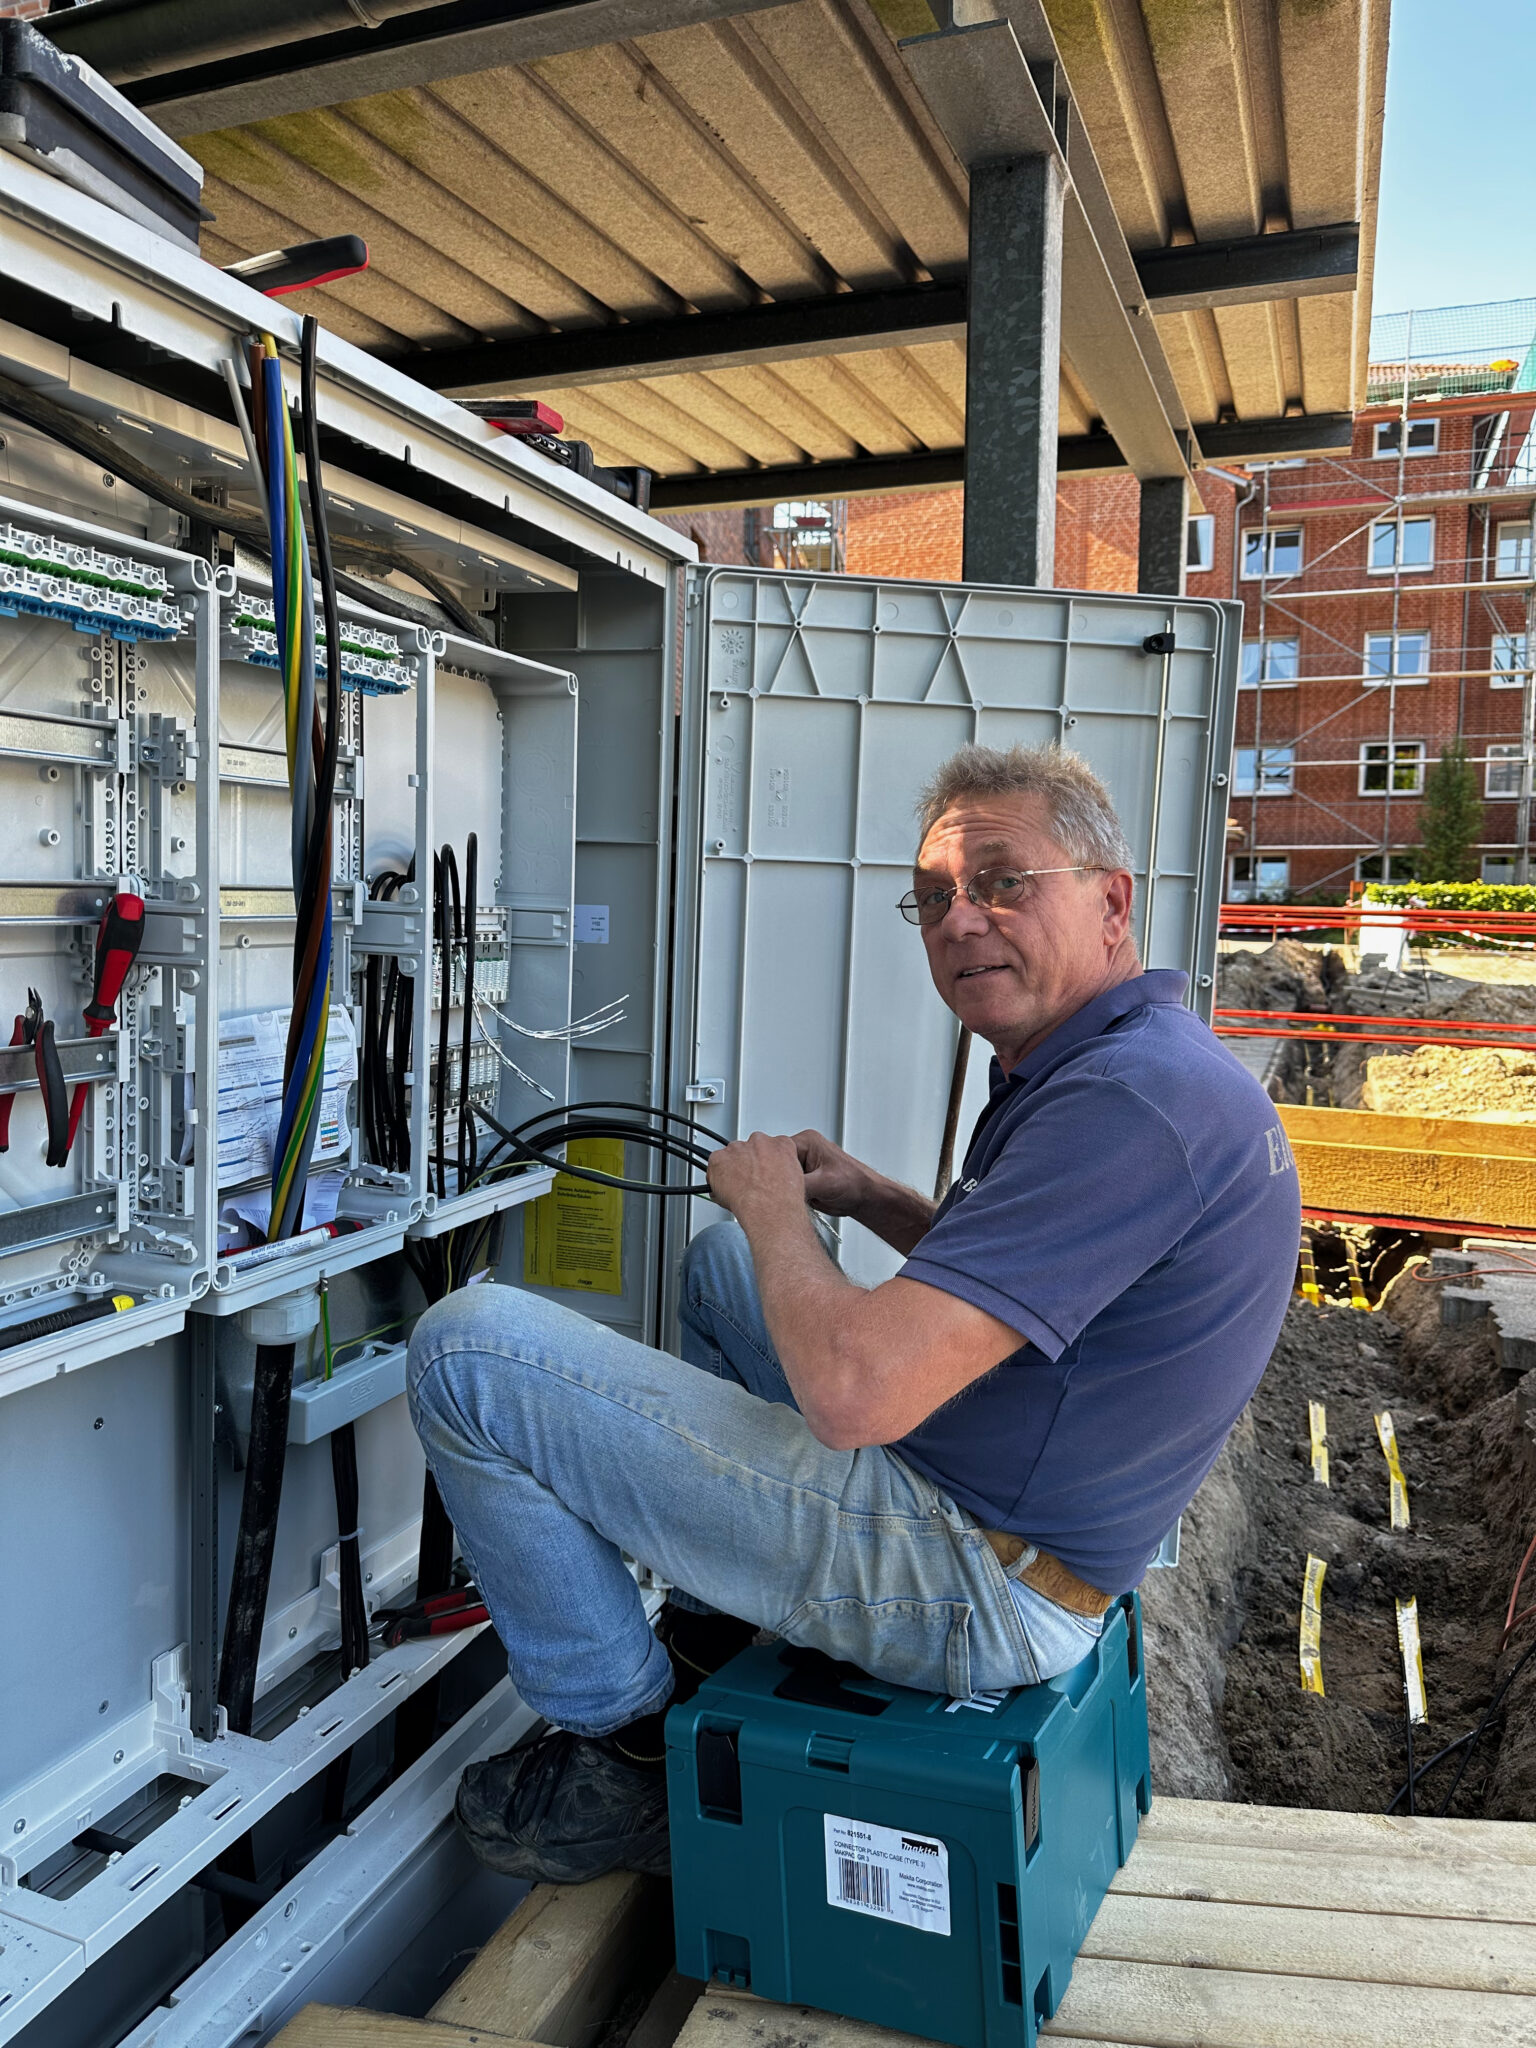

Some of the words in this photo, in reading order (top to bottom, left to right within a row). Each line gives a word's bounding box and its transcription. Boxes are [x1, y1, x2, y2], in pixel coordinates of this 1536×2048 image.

[847, 1829, 872, 1842] 821551-8
[834, 1848, 855, 1859] MAKPAC
[834, 1840, 866, 1854] CONNECTOR
[867, 1848, 888, 1859] PLASTIC
[888, 1853, 903, 1863] CASE
[904, 1856, 920, 1867] (TYPE
[920, 1861, 926, 1869] 3)
[899, 1872, 915, 1882] Makita
[915, 1876, 943, 1890] Corporation
